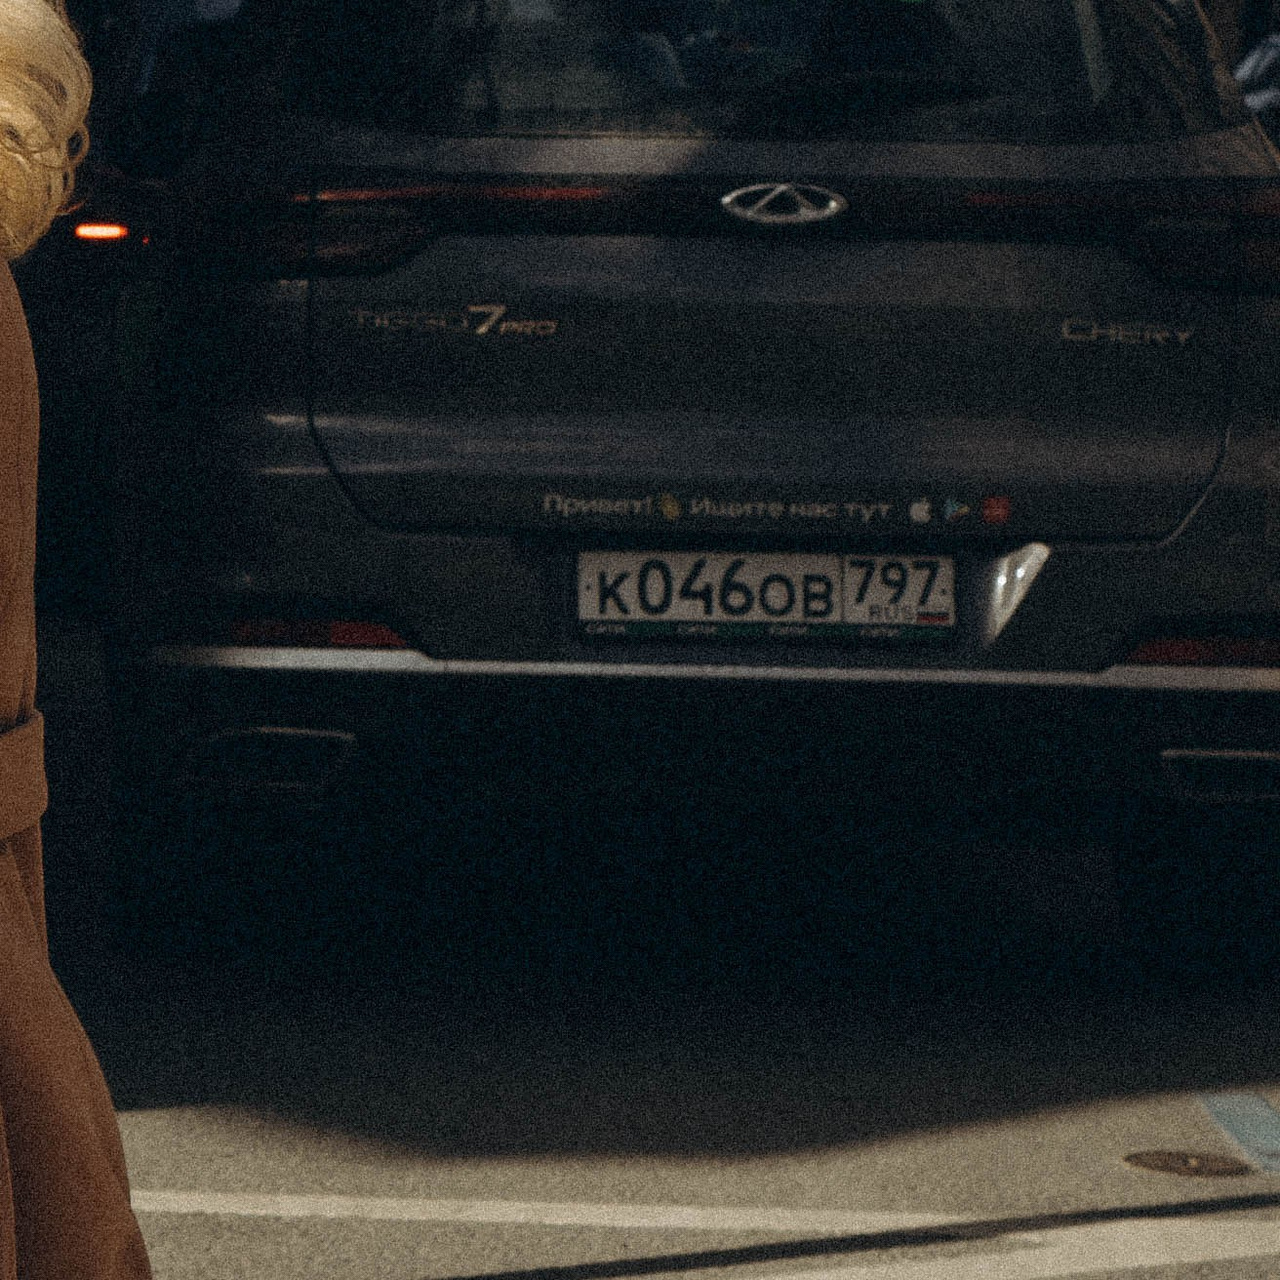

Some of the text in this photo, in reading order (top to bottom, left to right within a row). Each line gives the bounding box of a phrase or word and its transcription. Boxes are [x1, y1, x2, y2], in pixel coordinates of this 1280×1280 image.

[1061, 318, 1195, 345] CHERY
[542, 493, 652, 517] Привет!
[844, 502, 892, 522] тут
[848, 558, 941, 605] 797
